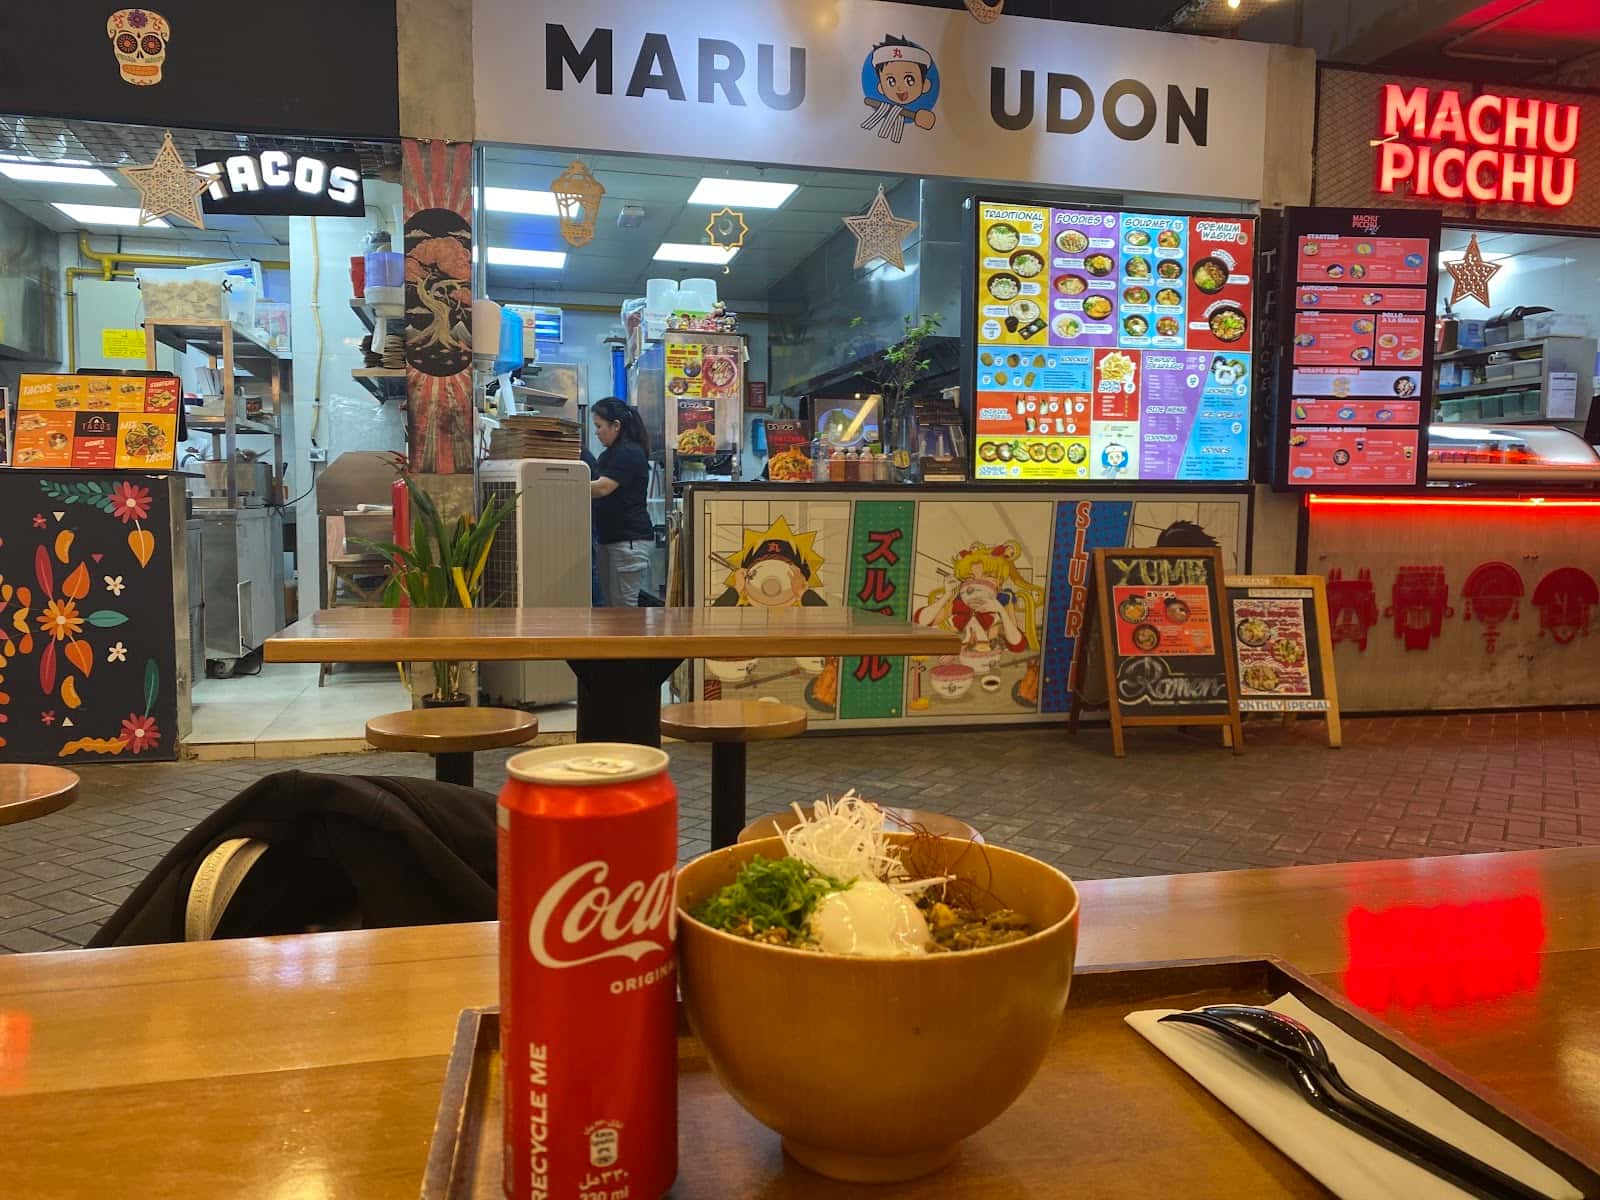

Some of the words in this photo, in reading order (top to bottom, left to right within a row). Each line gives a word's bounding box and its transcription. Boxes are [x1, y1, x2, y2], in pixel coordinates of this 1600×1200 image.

[546, 23, 806, 111] MARU
[990, 66, 1209, 147] UDON
[1382, 84, 1580, 154] MACHU
[197, 149, 360, 204] TACOS
[1378, 142, 1578, 206] PICCHU
[984, 209, 1044, 221] TRADITIONAL
[1056, 214, 1102, 226] FOODIES
[1125, 218, 1171, 229] GOURMET
[1196, 221, 1241, 233] PREMIUM
[1202, 231, 1238, 242] WAGYU
[855, 529, 903, 682] ズルル
[1065, 501, 1092, 691] SLURR
[1238, 700, 1283, 711] ONTHLY
[1286, 701, 1329, 712] SPECIAL
[529, 1042, 547, 1085] ME
